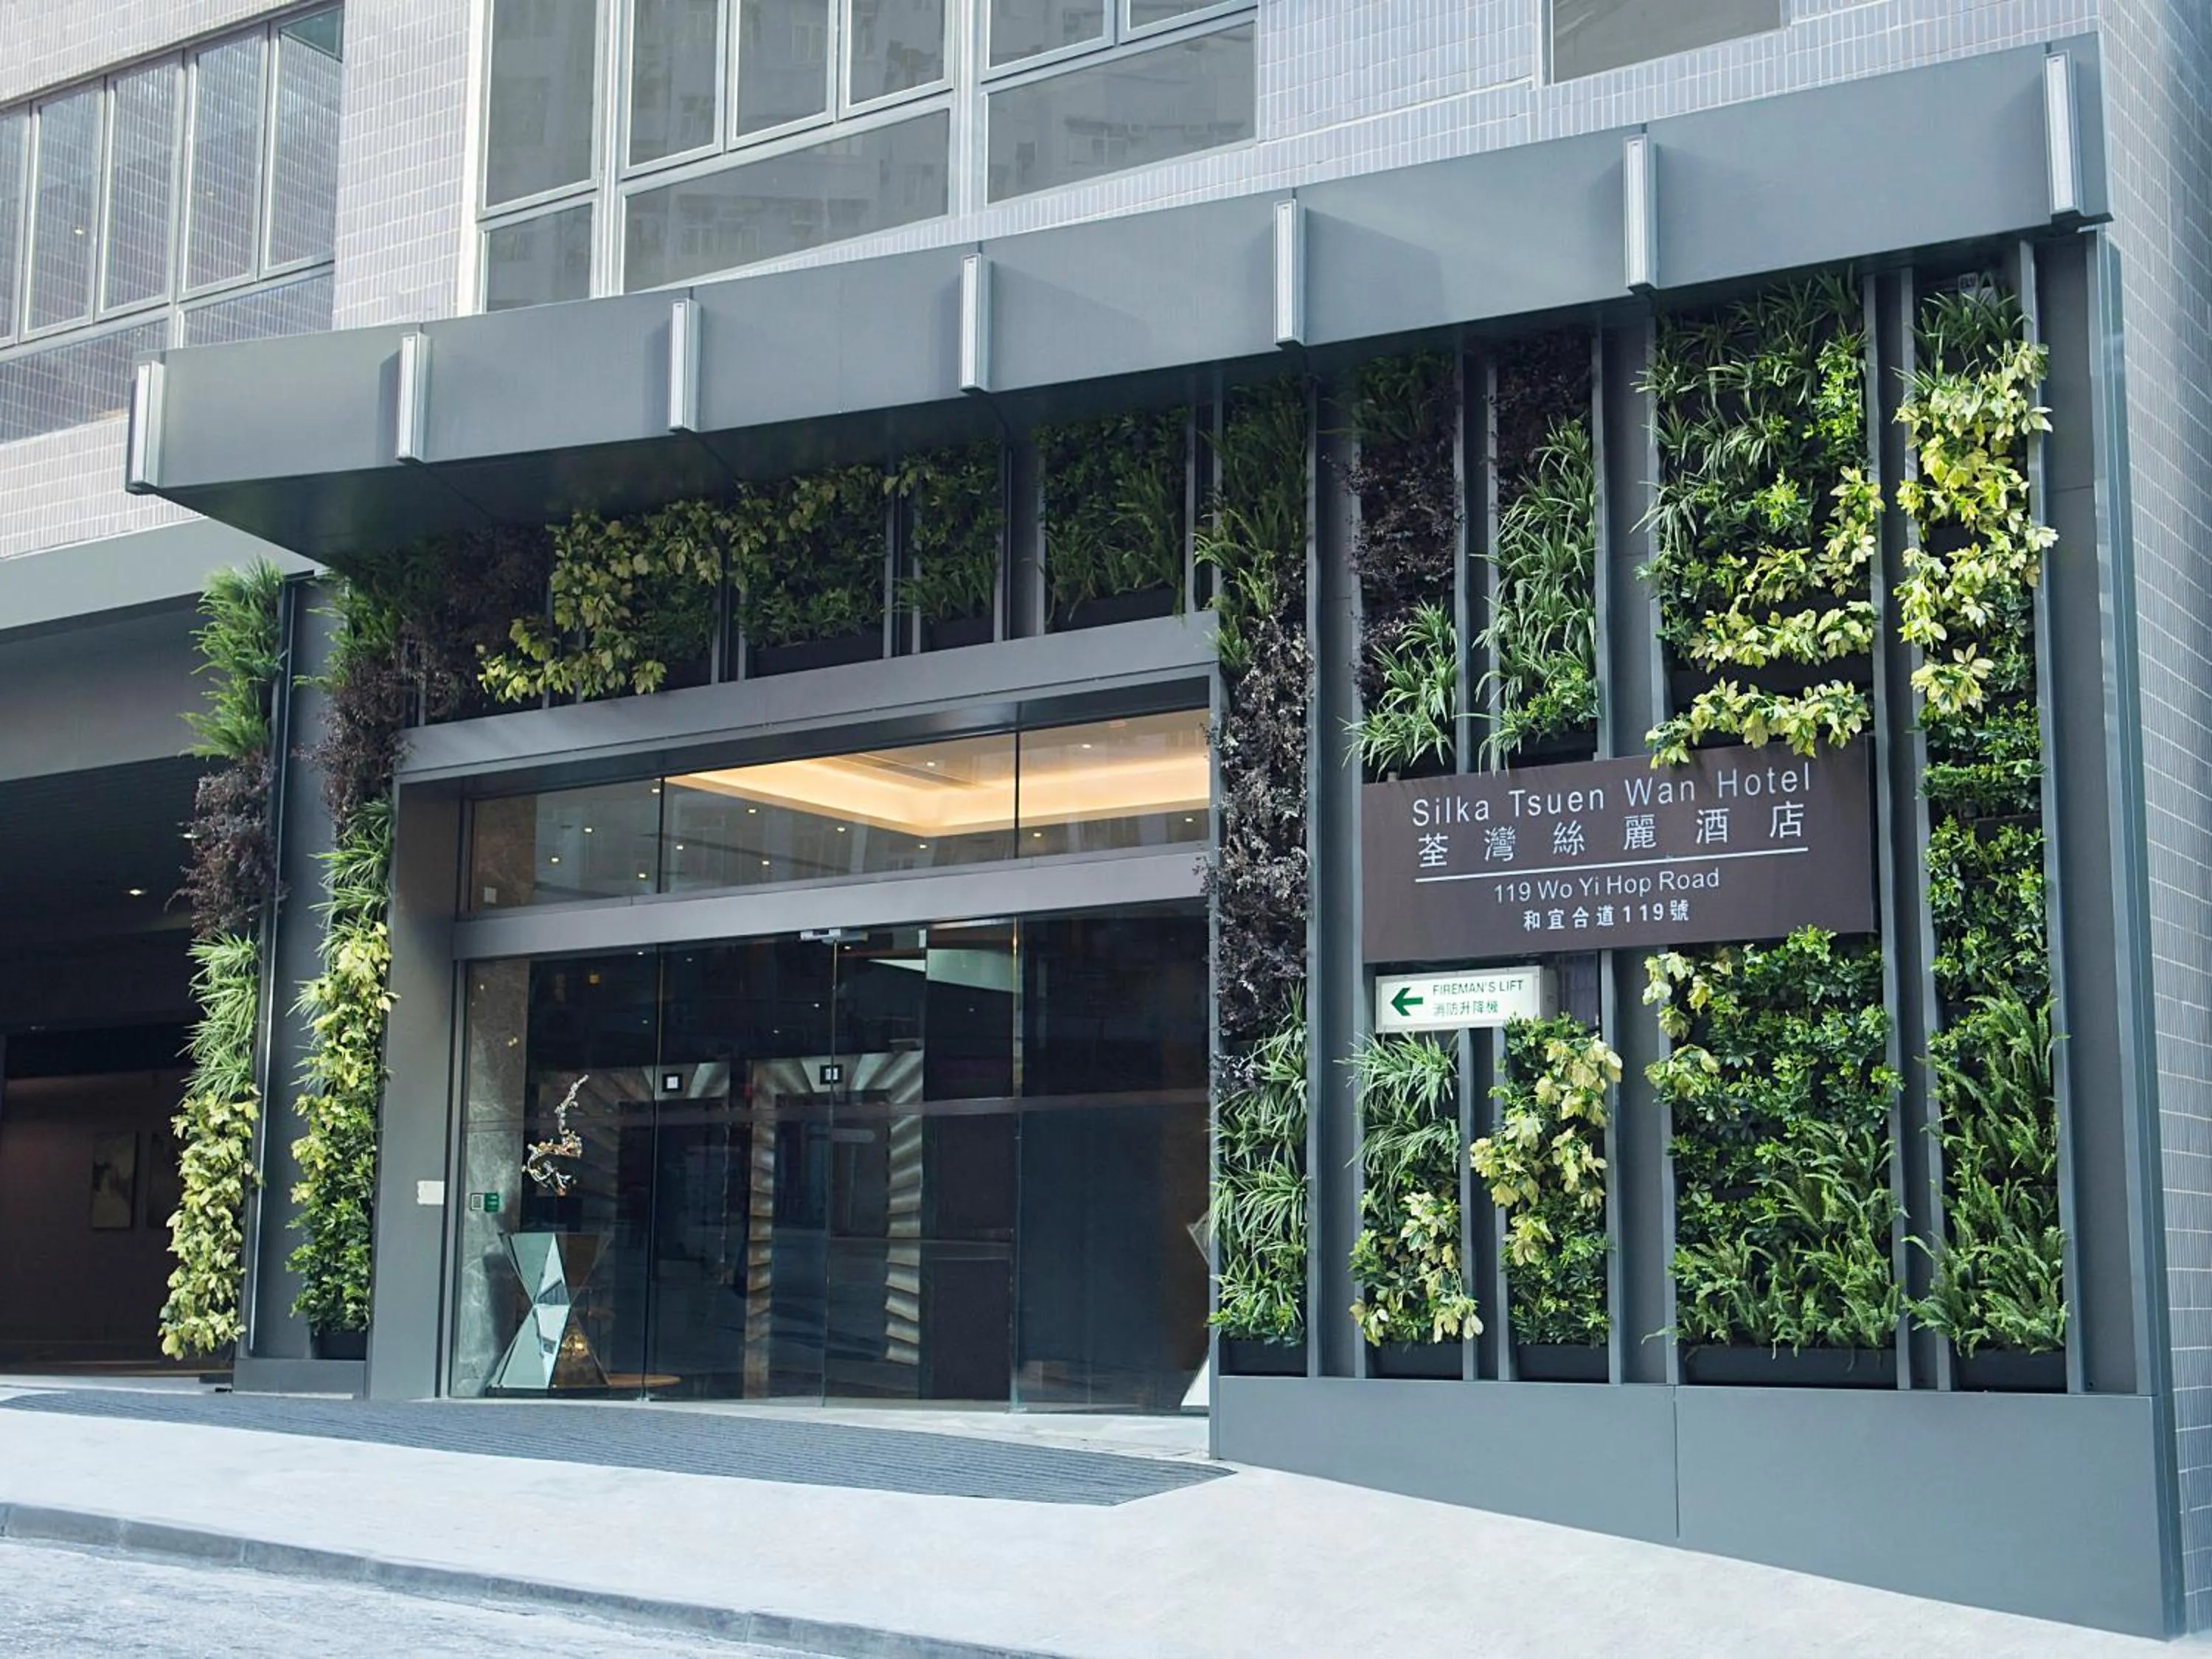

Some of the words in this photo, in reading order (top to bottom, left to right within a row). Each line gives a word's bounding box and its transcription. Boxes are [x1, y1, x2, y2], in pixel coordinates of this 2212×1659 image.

[1412, 796, 1489, 827] Silka
[1508, 788, 1604, 817] Tsuen
[1624, 776, 1695, 807] Wan
[1718, 762, 1809, 799] Hotel
[1418, 801, 1805, 868] 荃灣絲麗酒店
[1494, 881, 1531, 903] 119
[1537, 880, 1573, 900] Wo
[1579, 876, 1600, 897] Yi
[1607, 874, 1652, 897] Hop
[1659, 867, 1719, 891] Road
[1523, 899, 1689, 931] 和宜合道119號
[1433, 981, 1496, 996] FIREMAN'S
[1499, 979, 1524, 992] LIFT
